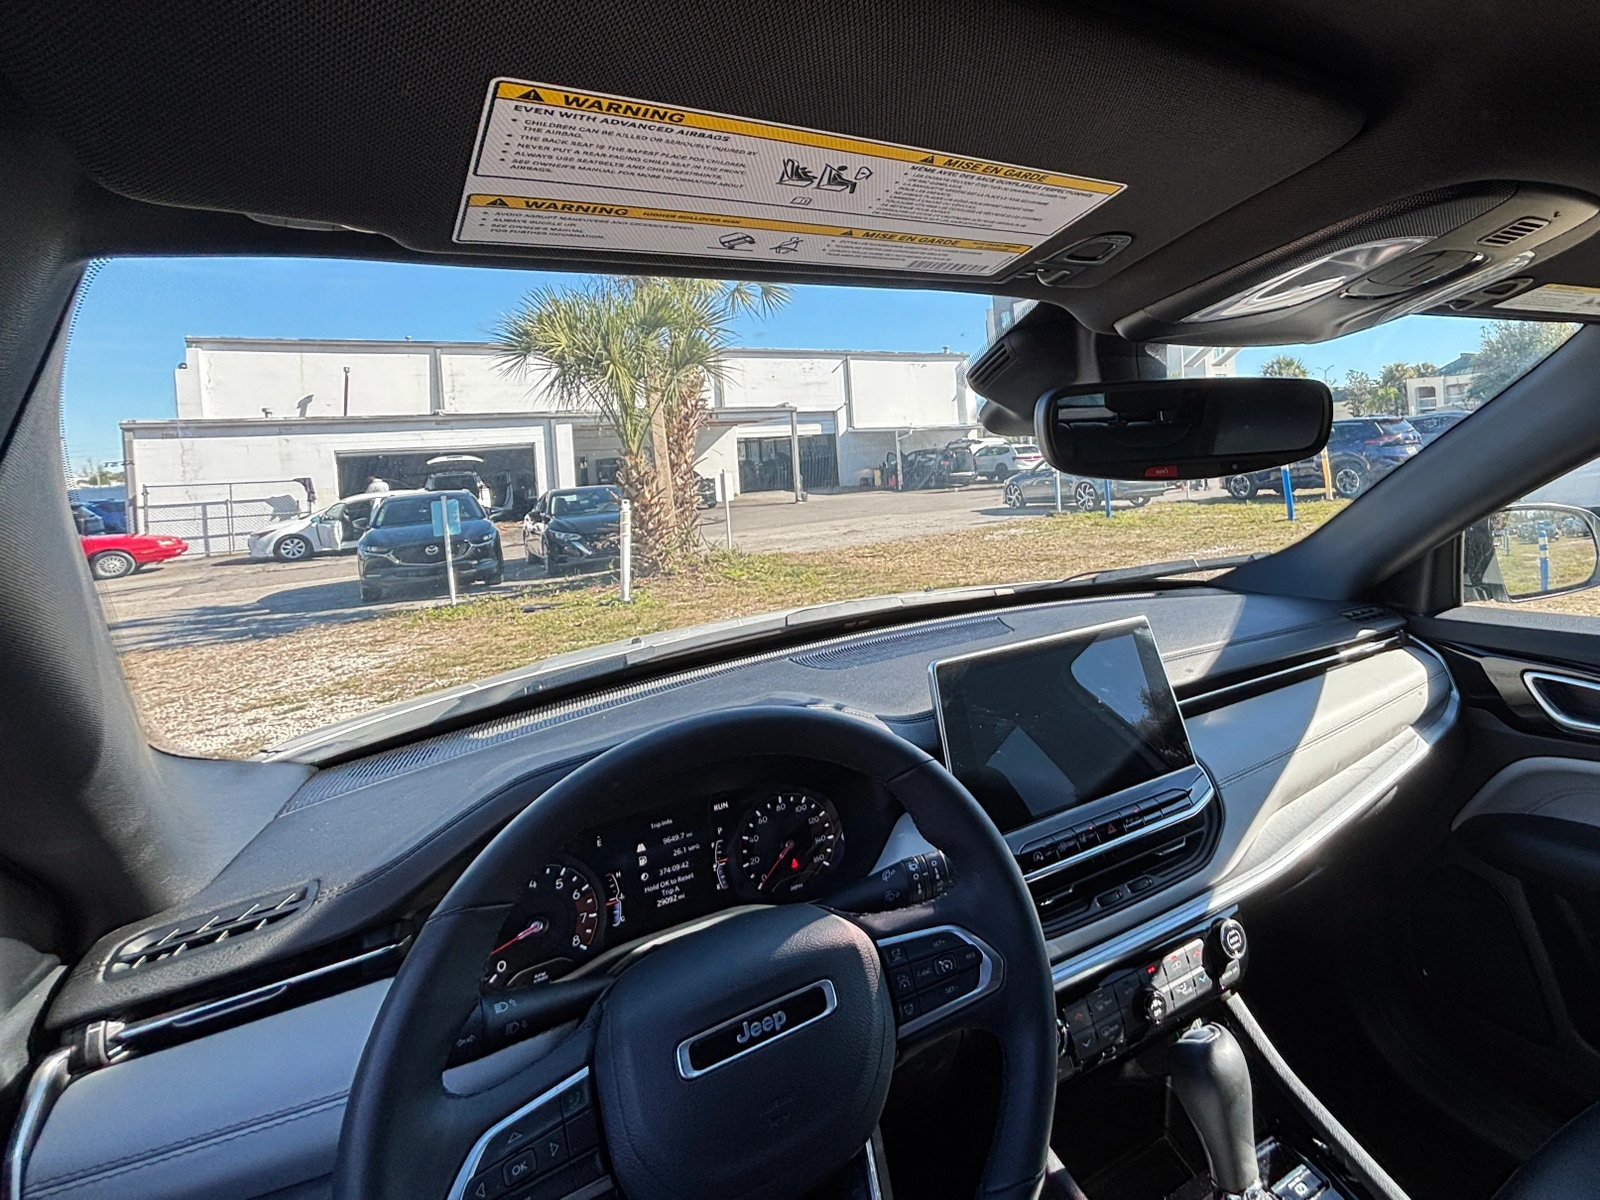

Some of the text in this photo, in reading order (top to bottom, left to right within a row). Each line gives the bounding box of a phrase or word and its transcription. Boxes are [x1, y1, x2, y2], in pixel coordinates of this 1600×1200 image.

[563, 94, 685, 123] WARNING
[513, 104, 731, 142] EVEN WITH ADVANCED AIRBAGS
[523, 125, 543, 133] THE
[524, 119, 577, 131] CHILDREN
[578, 126, 599, 134] CAN
[615, 131, 648, 141] KILLED
[664, 138, 711, 149] SERIOUSLY
[711, 145, 746, 155] INJURED
[517, 142, 550, 152] NEVER
[582, 151, 641, 162] REAR-FACING
[519, 134, 540, 142] THE
[542, 137, 568, 145] BACK
[570, 141, 594, 149] SEAT
[627, 147, 659, 157] SAFEST
[660, 152, 688, 160] PLACE
[514, 151, 553, 160] ALWAYS
[577, 158, 624, 168] SEATBELTS
[647, 166, 672, 174] CHILD
[943, 159, 1049, 182] MISE EN GARDE
[523, 200, 628, 215] WARNING
[862, 231, 897, 240] MISE
[918, 236, 960, 246] GARDE
[713, 801, 729, 811] RUN
[776, 803, 786, 812] 80
[795, 804, 807, 813] 100
[650, 818, 673, 829] Trip Info
[758, 816, 768, 824] 60
[750, 856, 760, 865] 20
[528, 880, 537, 888] 4
[555, 878, 564, 889] 5
[644, 883, 660, 893] Hold
[660, 880, 670, 888] OK
[677, 872, 694, 882] Reset
[572, 888, 581, 900] 6
[661, 887, 673, 896] Trip
[580, 912, 587, 923] 7
[572, 935, 581, 947] 8
[497, 960, 506, 972] 0
[736, 1009, 787, 1044] Jeep
[512, 1160, 528, 1175] OK
